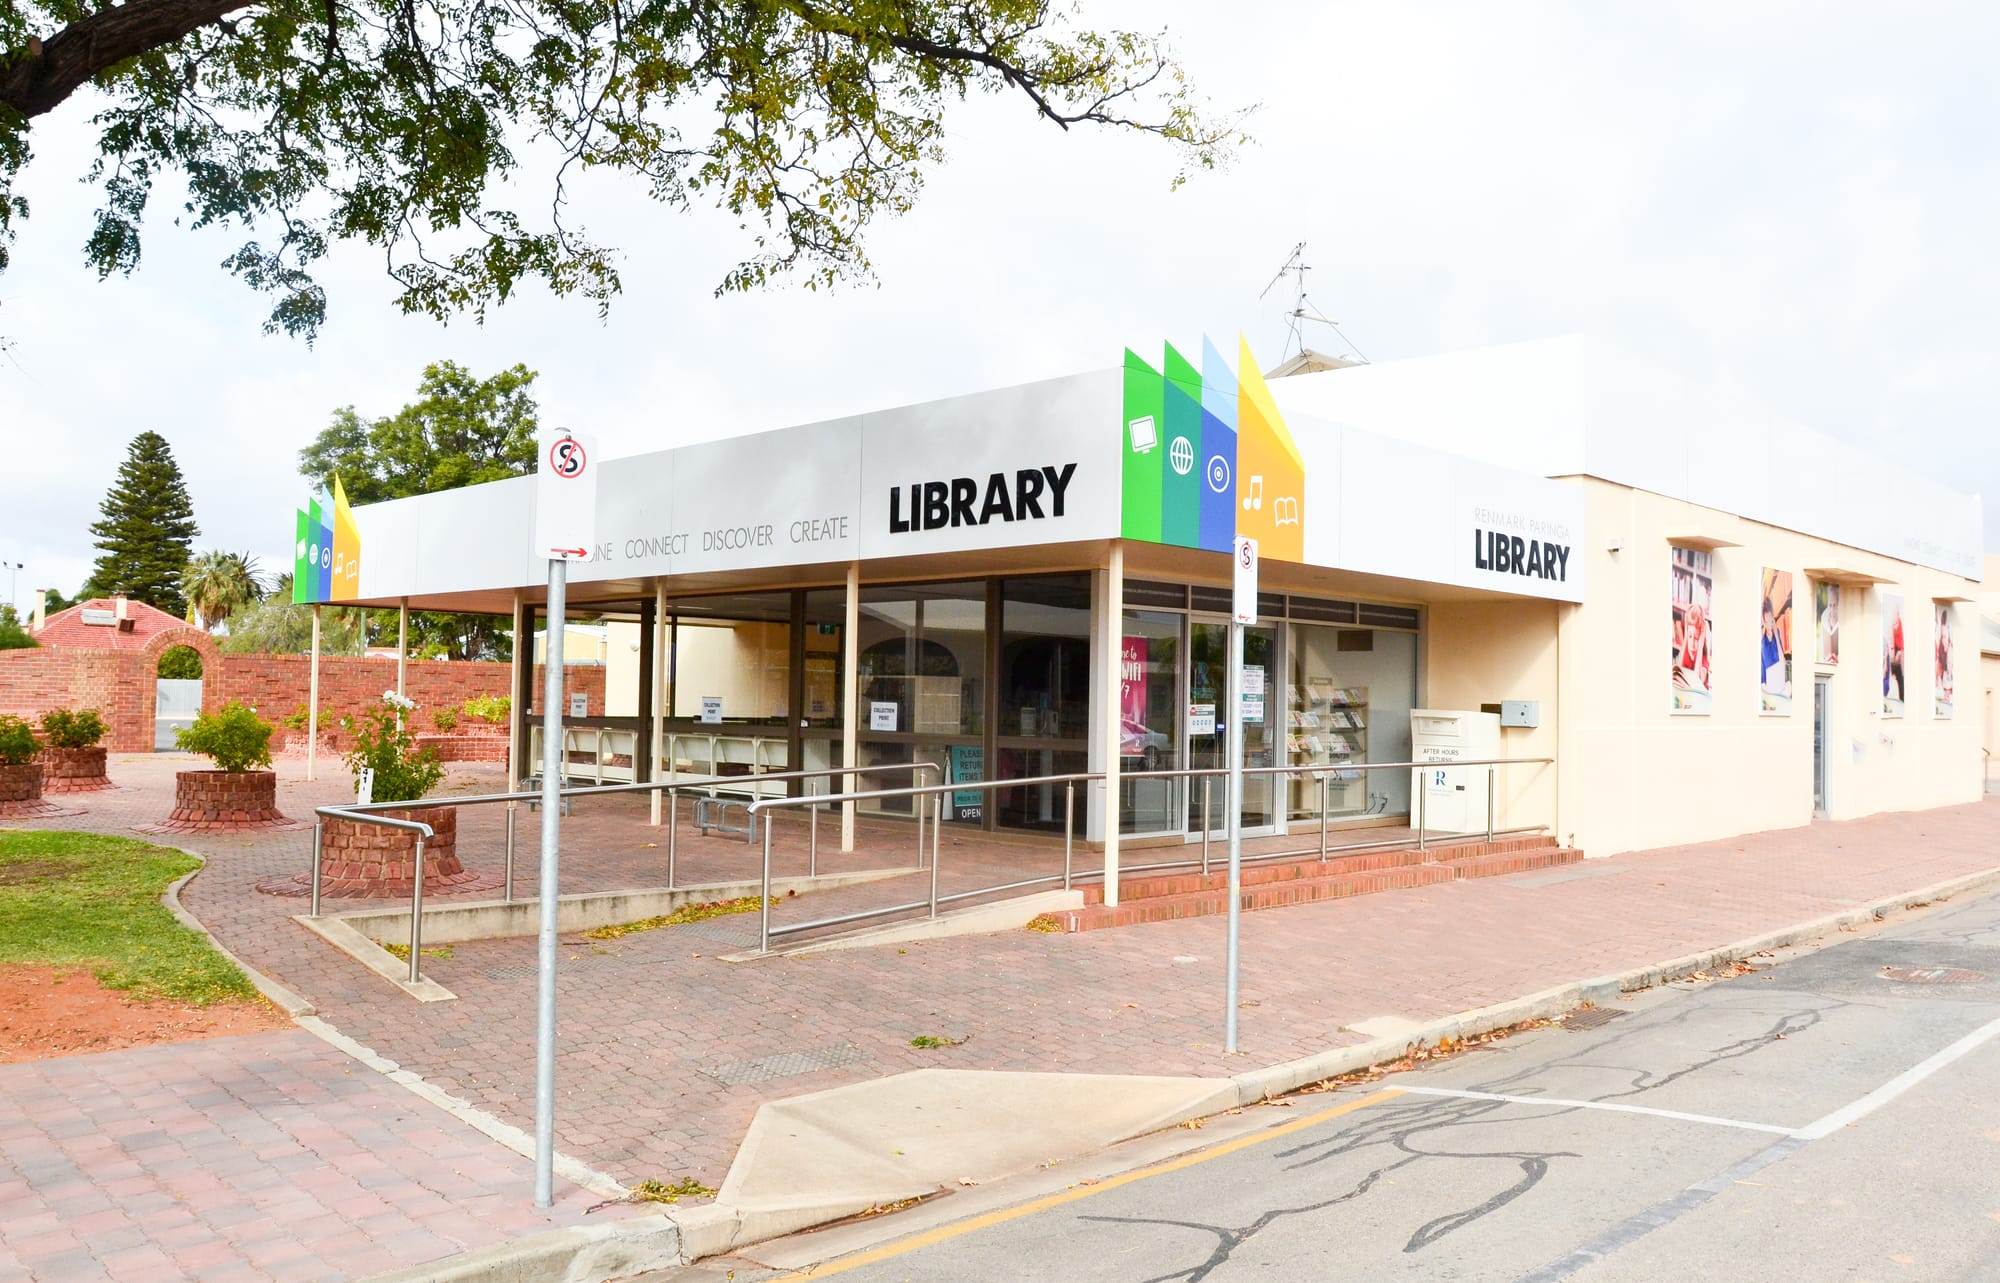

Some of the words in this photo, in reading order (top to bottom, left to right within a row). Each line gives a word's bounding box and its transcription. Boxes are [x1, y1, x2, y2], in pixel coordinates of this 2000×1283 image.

[889, 463, 1078, 533] LIBRARY
[625, 534, 689, 559] CONNECT
[703, 524, 773, 551] DISCOVER
[790, 516, 848, 543] CREATE
[1474, 507, 1525, 530] RENMARK
[1529, 519, 1570, 539] PARINGA
[1475, 528, 1570, 582] LIBRARY
[961, 808, 981, 818] OPEN
